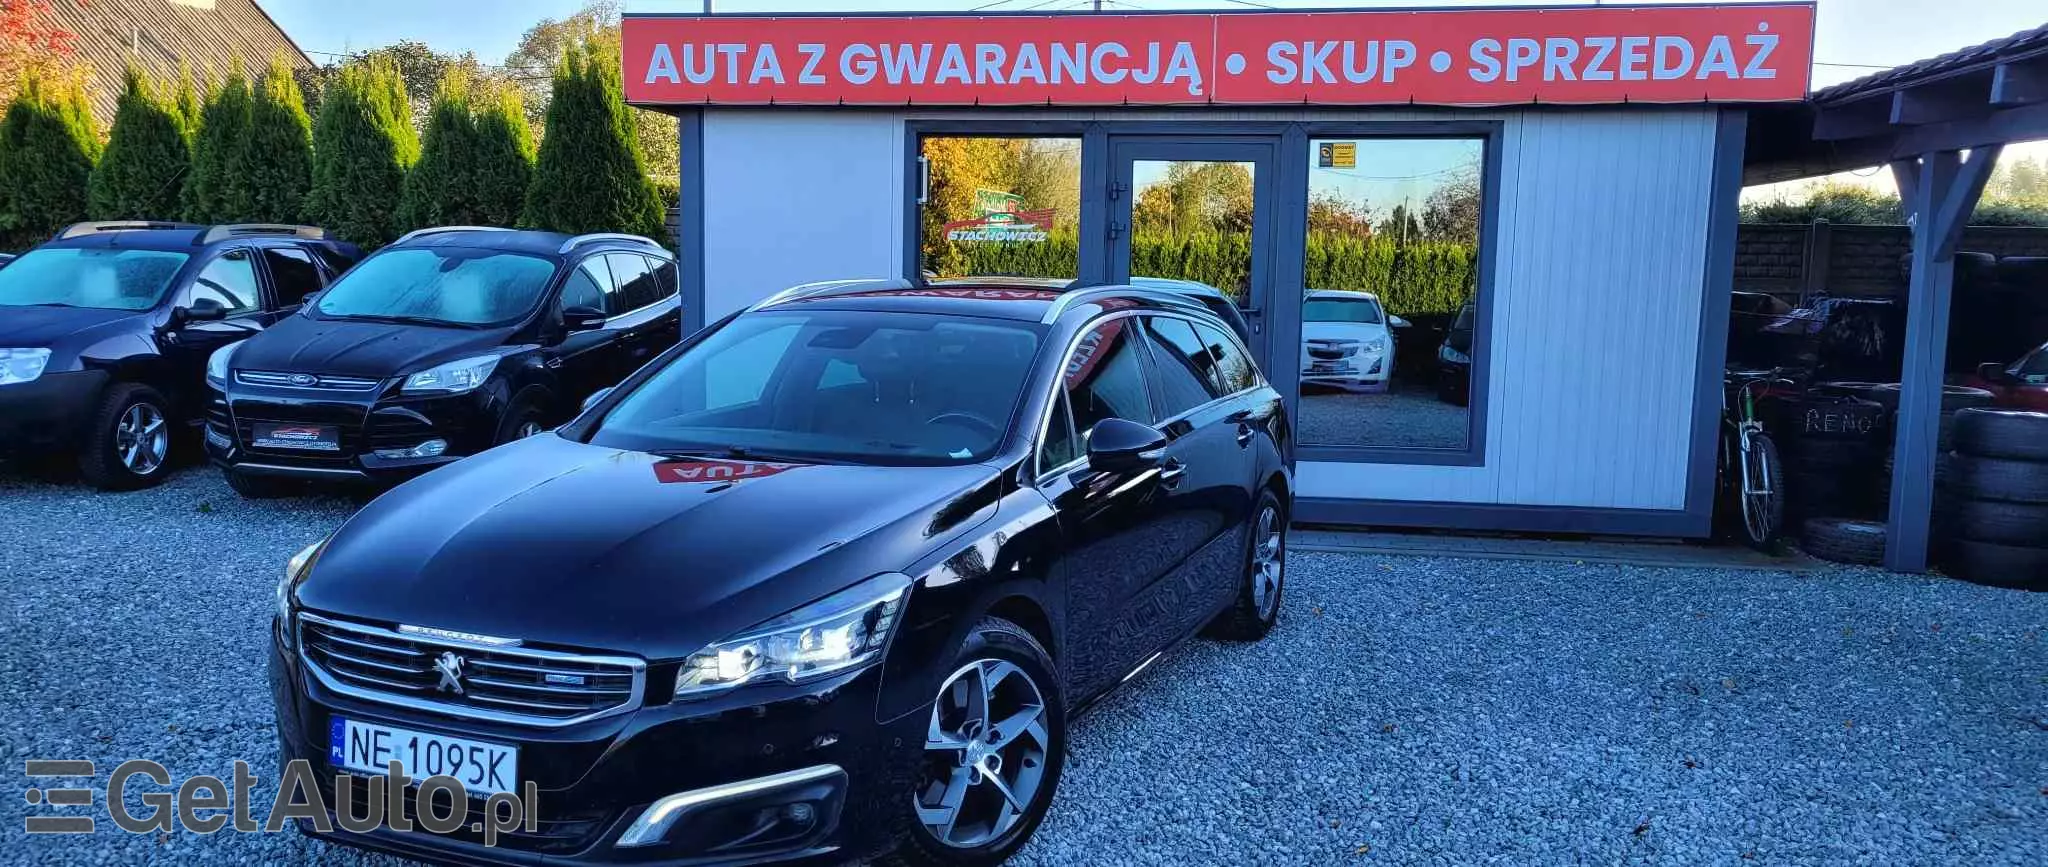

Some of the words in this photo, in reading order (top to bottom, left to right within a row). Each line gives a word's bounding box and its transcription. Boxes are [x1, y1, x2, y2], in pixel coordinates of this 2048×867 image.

[644, 43, 785, 84] AUTA
[798, 43, 826, 84] Z
[839, 42, 1203, 96] GWARANCJĄ
[1266, 40, 1417, 84] SKUP
[1468, 21, 1780, 83] SPRZEDAŻ
[947, 230, 1049, 241] STACHOWICZ
[332, 746, 343, 758] PL
[351, 726, 392, 770] NE
[408, 736, 508, 791] 1095K
